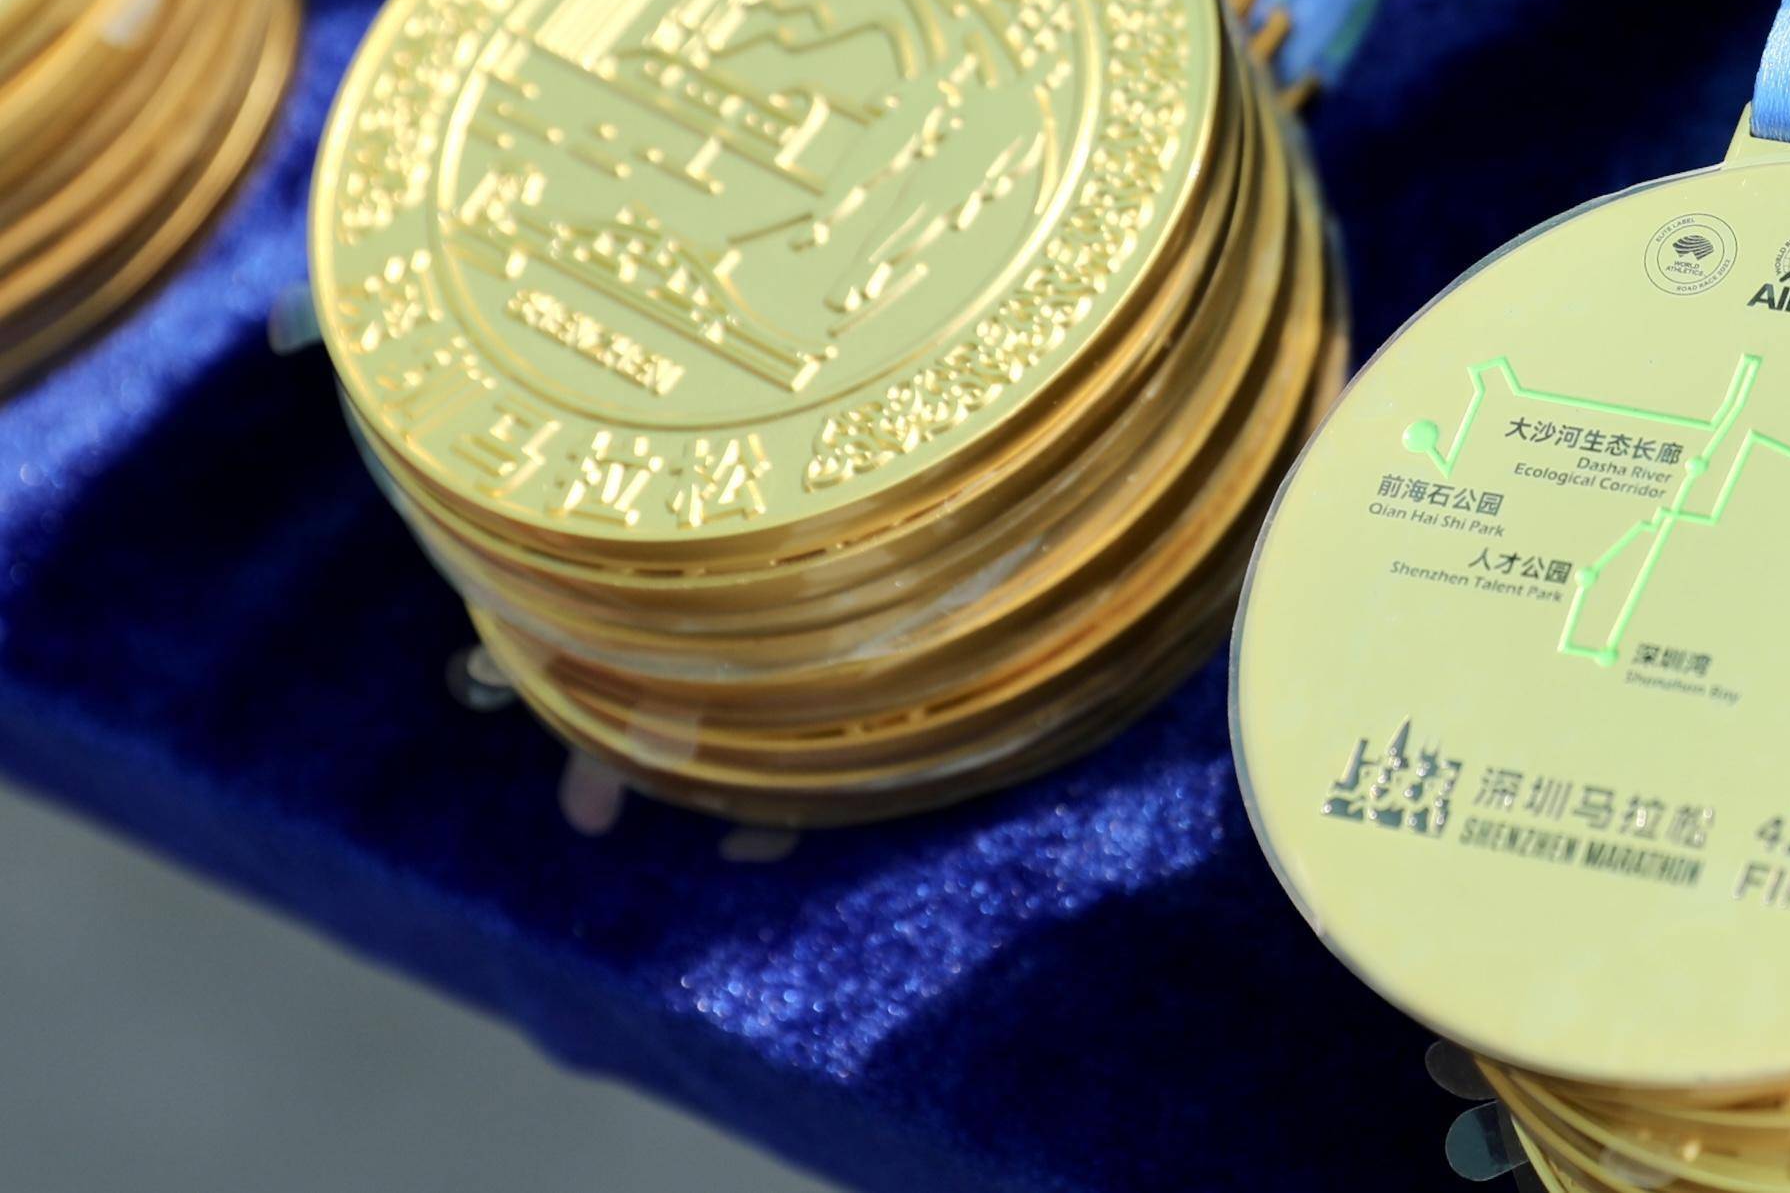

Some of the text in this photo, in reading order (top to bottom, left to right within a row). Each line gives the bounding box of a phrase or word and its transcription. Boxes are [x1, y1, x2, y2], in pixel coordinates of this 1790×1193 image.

[1672, 217, 1695, 229] LABEL
[1665, 265, 1704, 277] ATHLETICS
[1673, 260, 1700, 269] WORLD
[1774, 246, 1787, 275] WORLD
[1676, 283, 1698, 292] ROAD
[1698, 274, 1719, 289] RACE
[1504, 417, 1684, 466] 大沙河生态长廊
[1514, 462, 1667, 500] Ecological Corridor
[1577, 456, 1673, 484] Dasha River
[1376, 473, 1505, 517] 前海石公园
[1368, 501, 1505, 538] Qian Hai Shi Park
[1389, 560, 1563, 603] Shenzhen Talent Park
[1468, 547, 1573, 585] 人才公园
[1474, 767, 1716, 849] 深圳马拉松
[1459, 816, 1705, 890] SHENZHEN MARATHON
